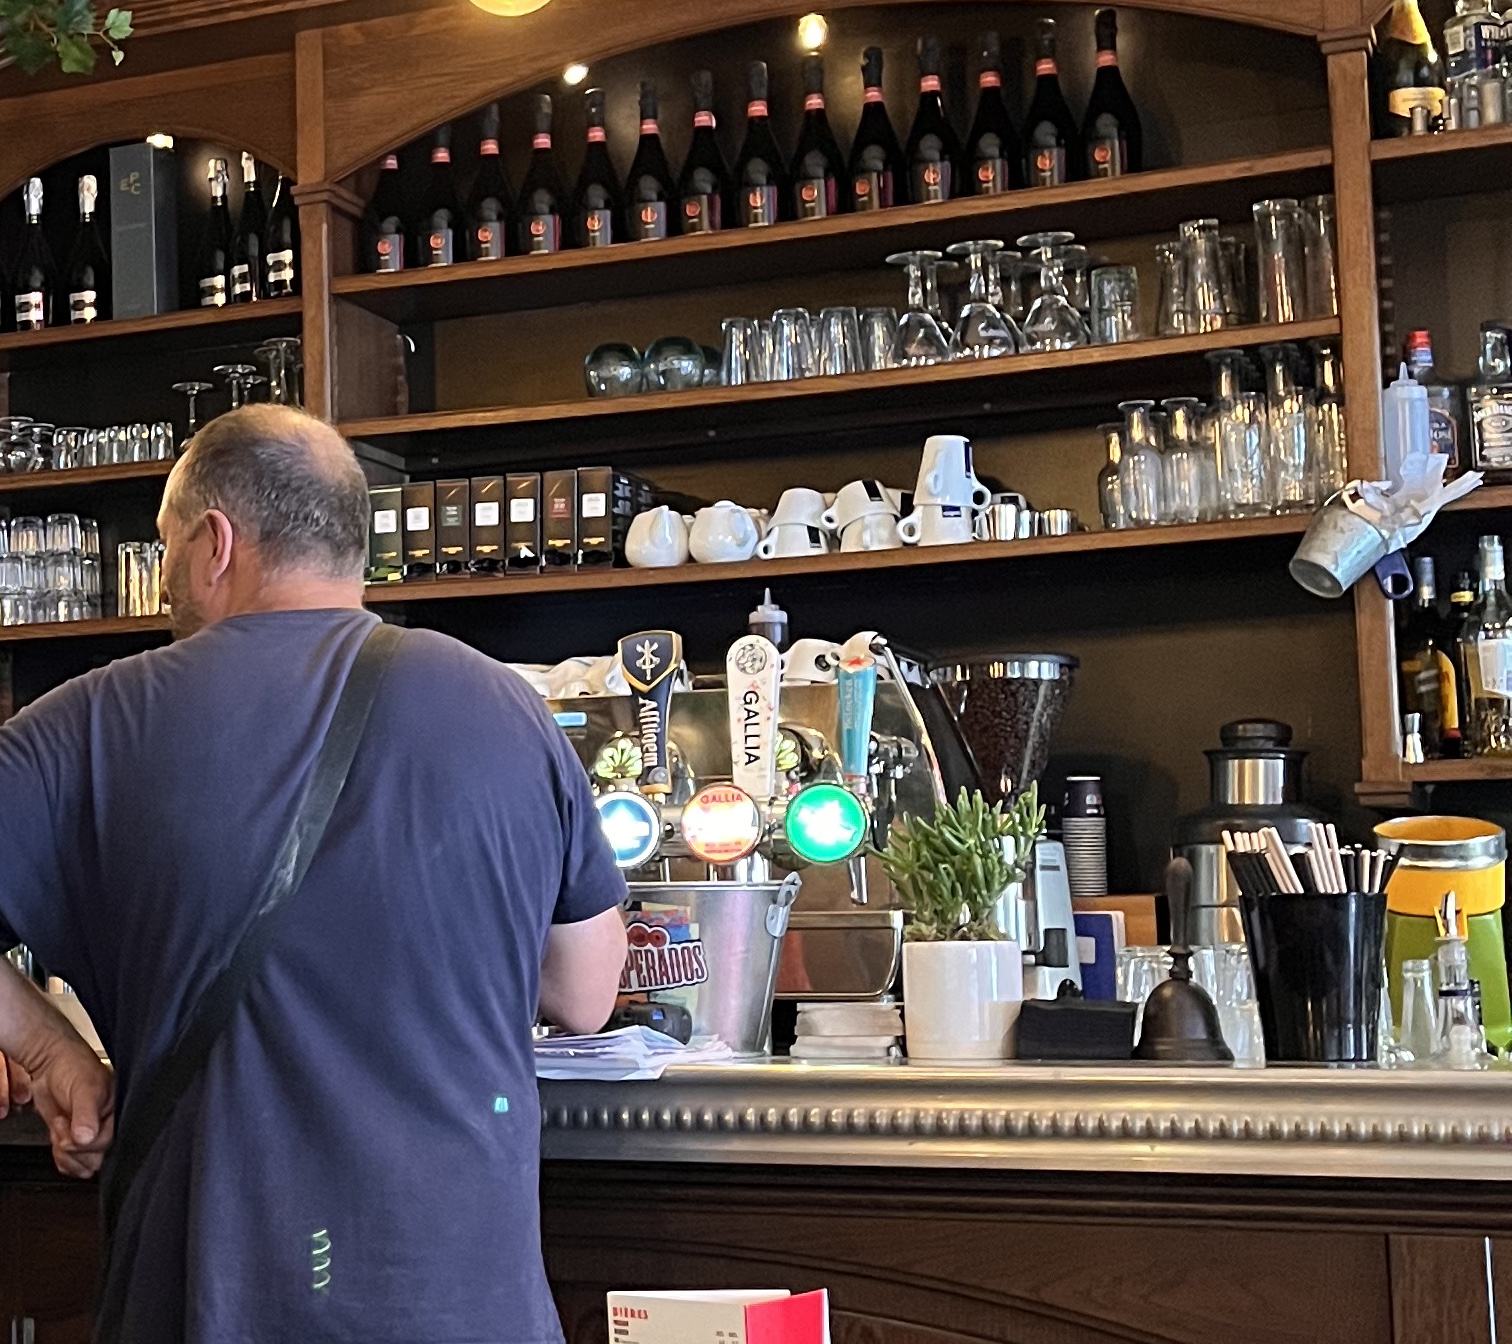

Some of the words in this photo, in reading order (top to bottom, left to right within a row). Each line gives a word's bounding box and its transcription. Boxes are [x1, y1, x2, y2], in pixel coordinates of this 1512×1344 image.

[638, 696, 661, 767] Affligem
[743, 690, 761, 767] GALLIA
[700, 793, 744, 805] GALLIA
